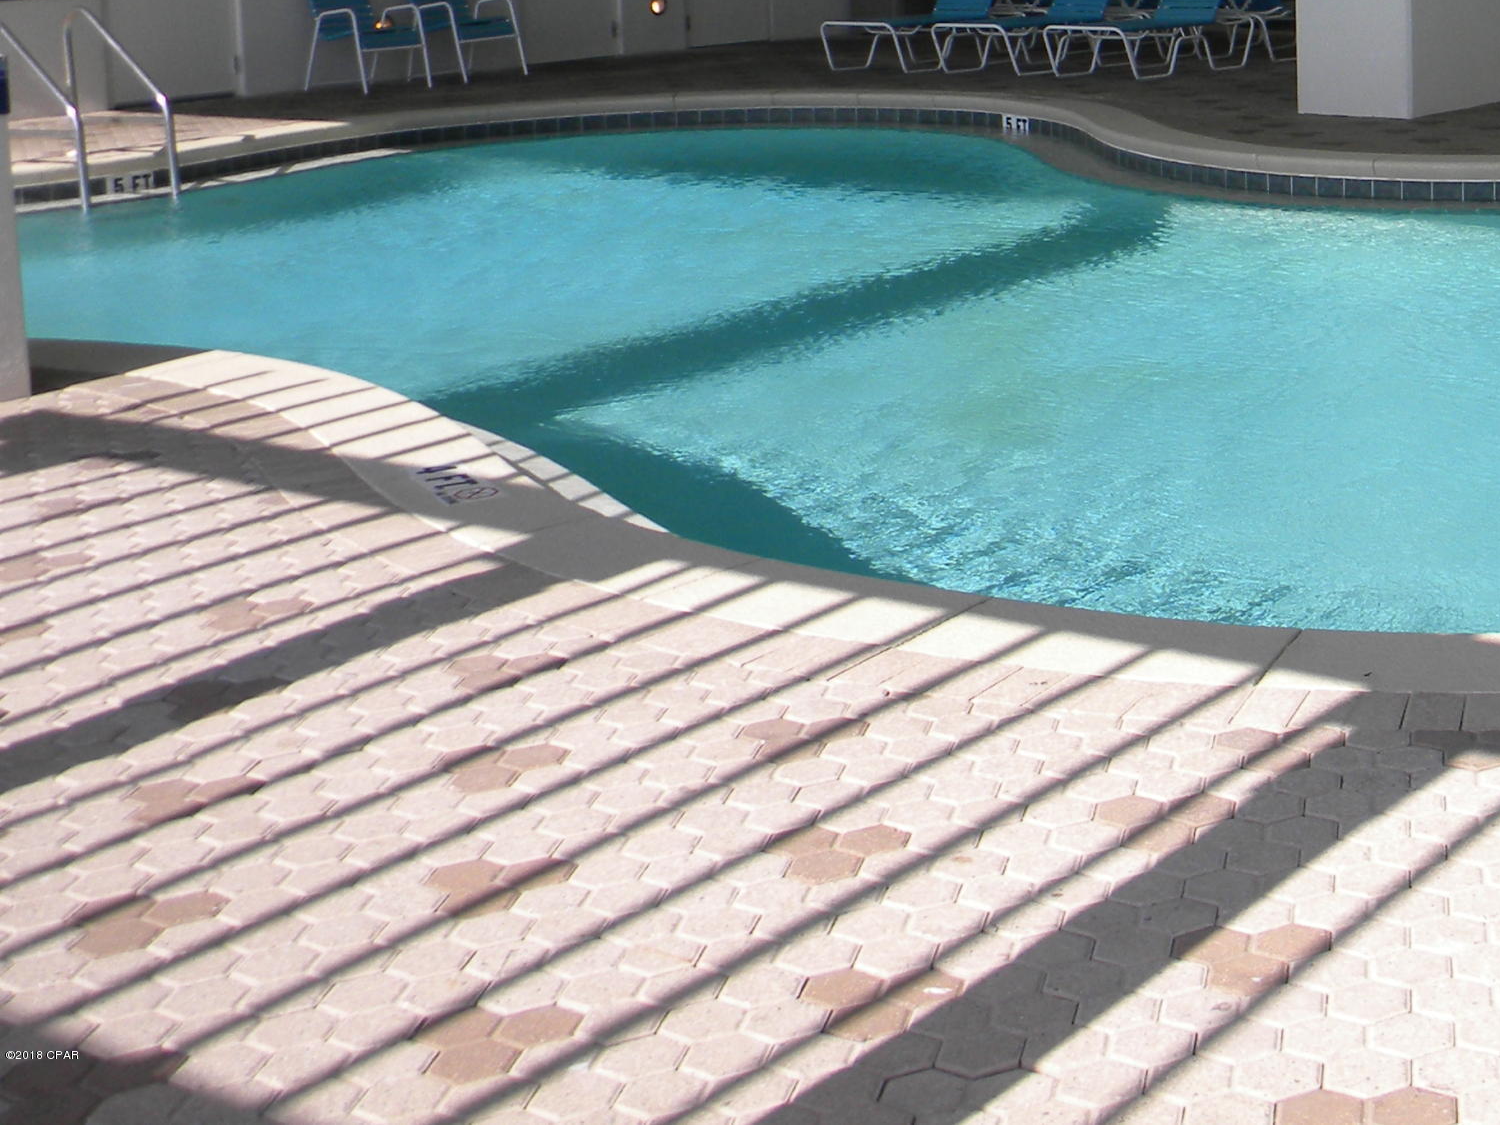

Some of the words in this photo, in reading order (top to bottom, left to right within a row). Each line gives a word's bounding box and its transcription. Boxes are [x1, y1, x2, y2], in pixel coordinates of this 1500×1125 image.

[1006, 116, 1013, 130] 5
[1016, 118, 1028, 132] FT
[113, 177, 124, 193] 5
[131, 174, 152, 192] FT
